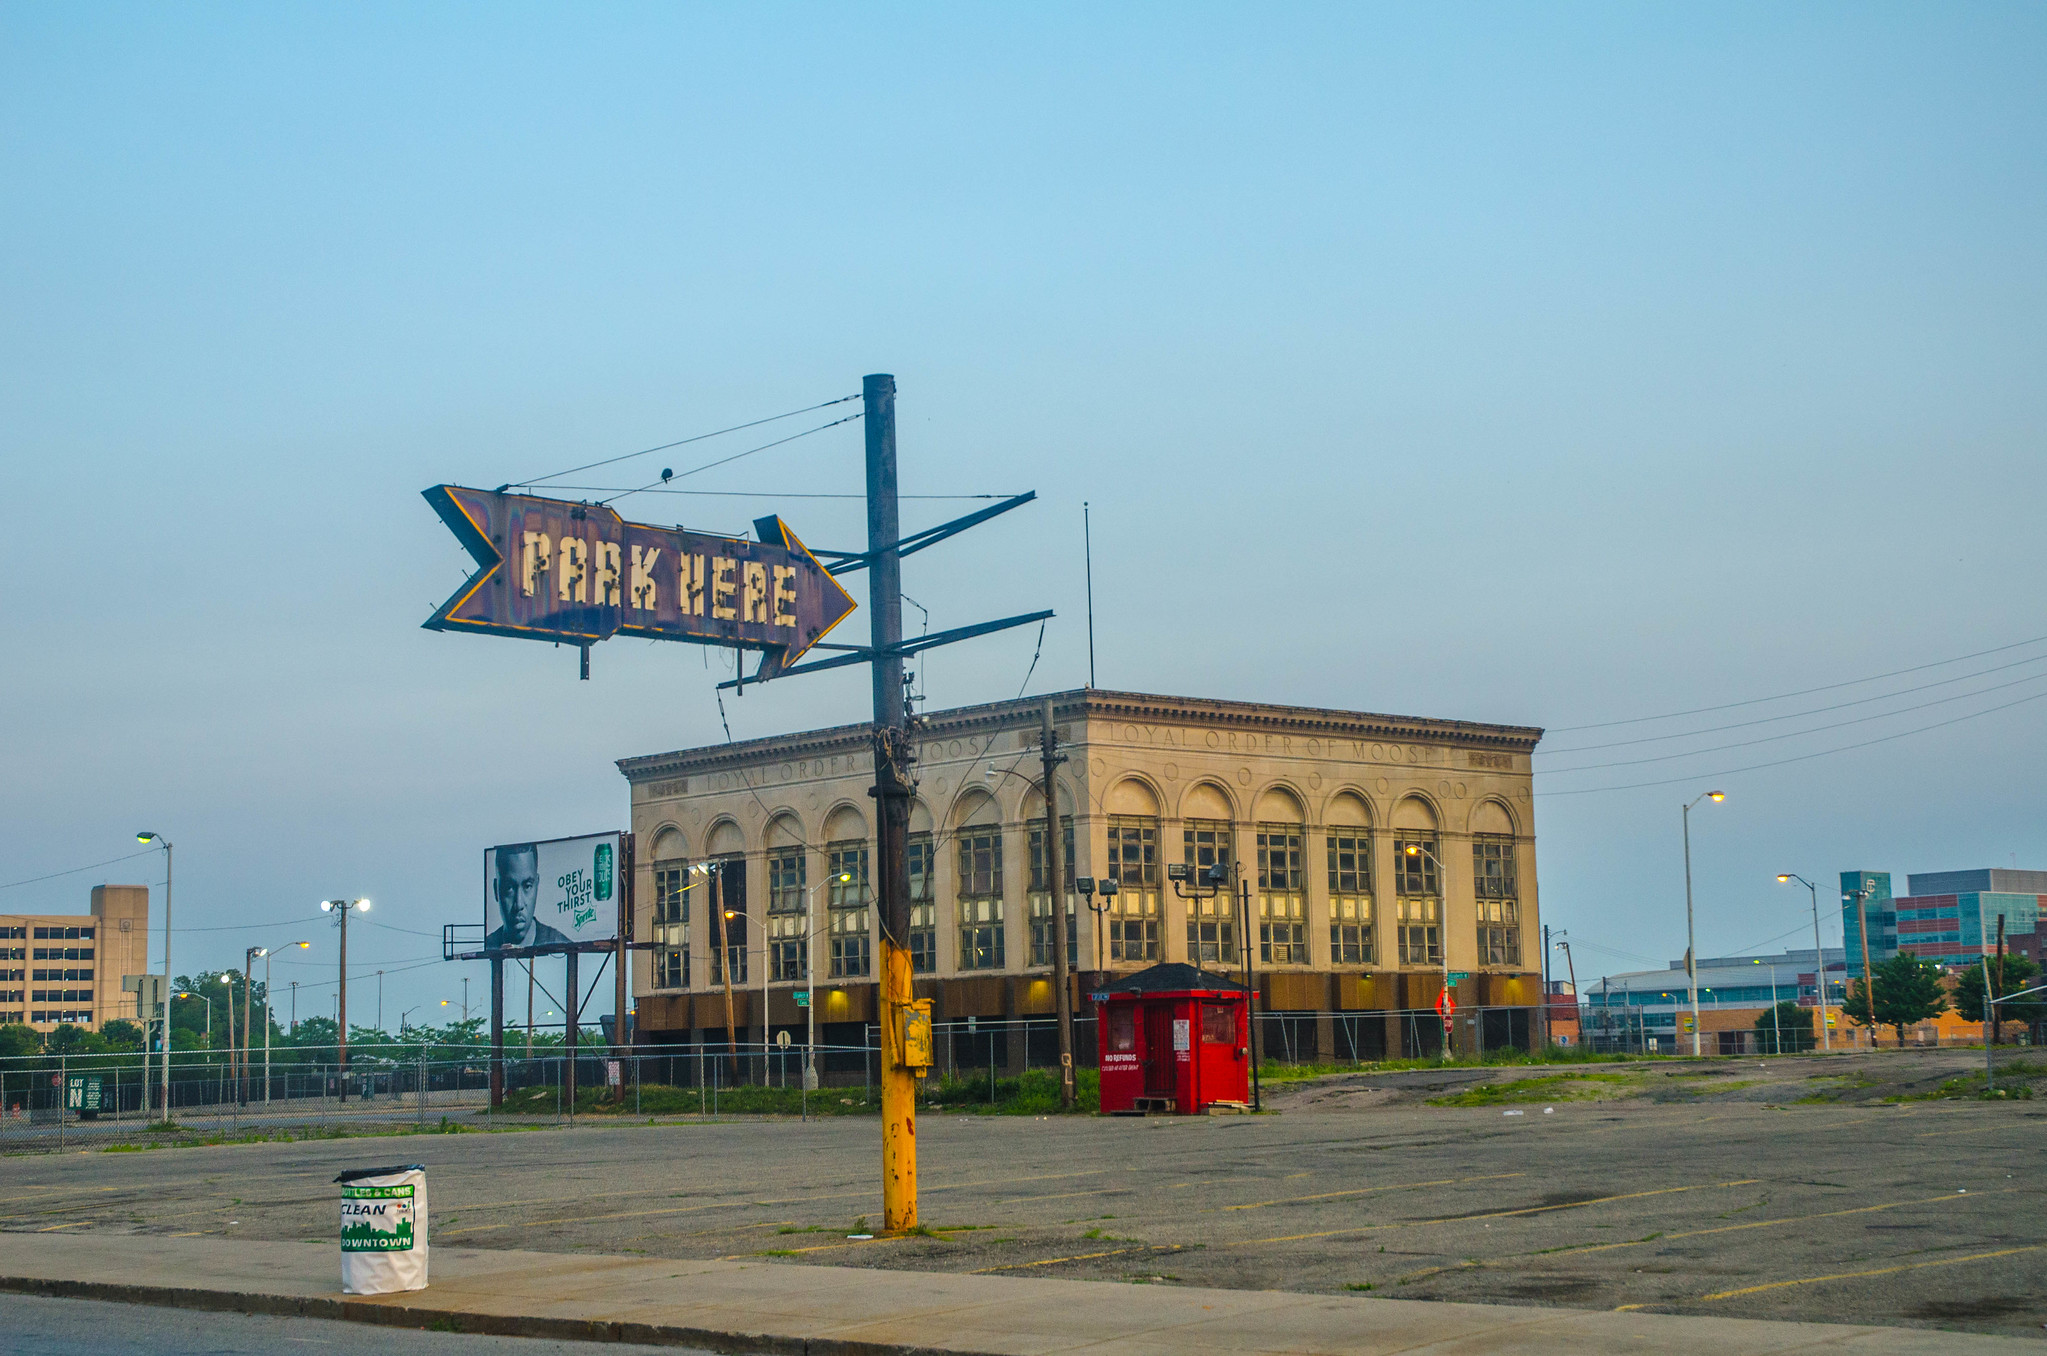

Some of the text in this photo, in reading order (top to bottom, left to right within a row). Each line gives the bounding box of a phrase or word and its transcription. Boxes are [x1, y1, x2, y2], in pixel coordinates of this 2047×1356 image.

[522, 530, 797, 628] PARK HERE
[1109, 723, 1434, 763] LOYAL ORDER OF MOOSE
[707, 767, 770, 791] LOYAL
[781, 755, 855, 780] ORDER
[558, 868, 584, 888] OBEY
[565, 879, 592, 896] YOUR
[557, 891, 592, 914] THIRST
[574, 907, 595, 928] Sprite
[1105, 1054, 1113, 1062] NO
[69, 1078, 84, 1088] LOT
[69, 1088, 83, 1108] N
[384, 1187, 411, 1196] CANS
[342, 1204, 387, 1215] CLEAN
[342, 1237, 411, 1247] DOWNTOWN
